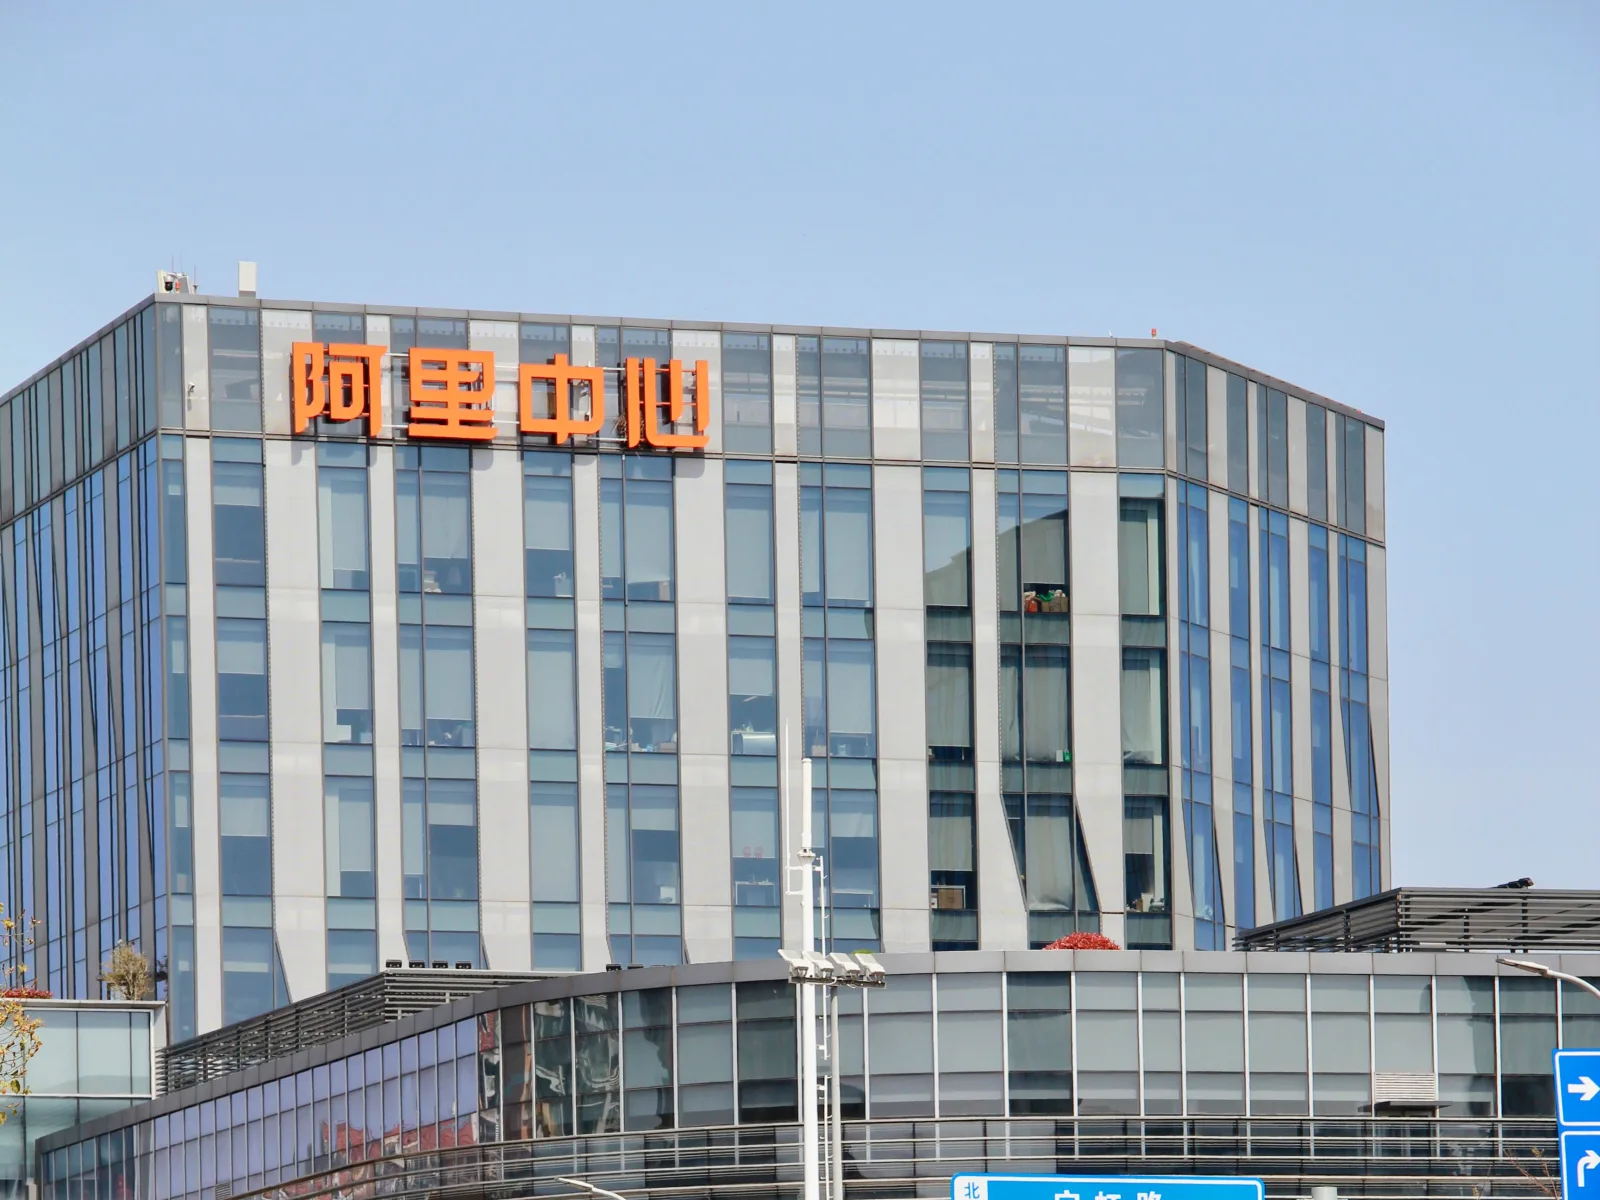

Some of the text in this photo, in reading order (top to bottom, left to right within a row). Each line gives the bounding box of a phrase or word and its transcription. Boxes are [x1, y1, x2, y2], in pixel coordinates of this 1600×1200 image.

[291, 341, 710, 448] 阿里中心
[964, 1182, 980, 1200] 北
